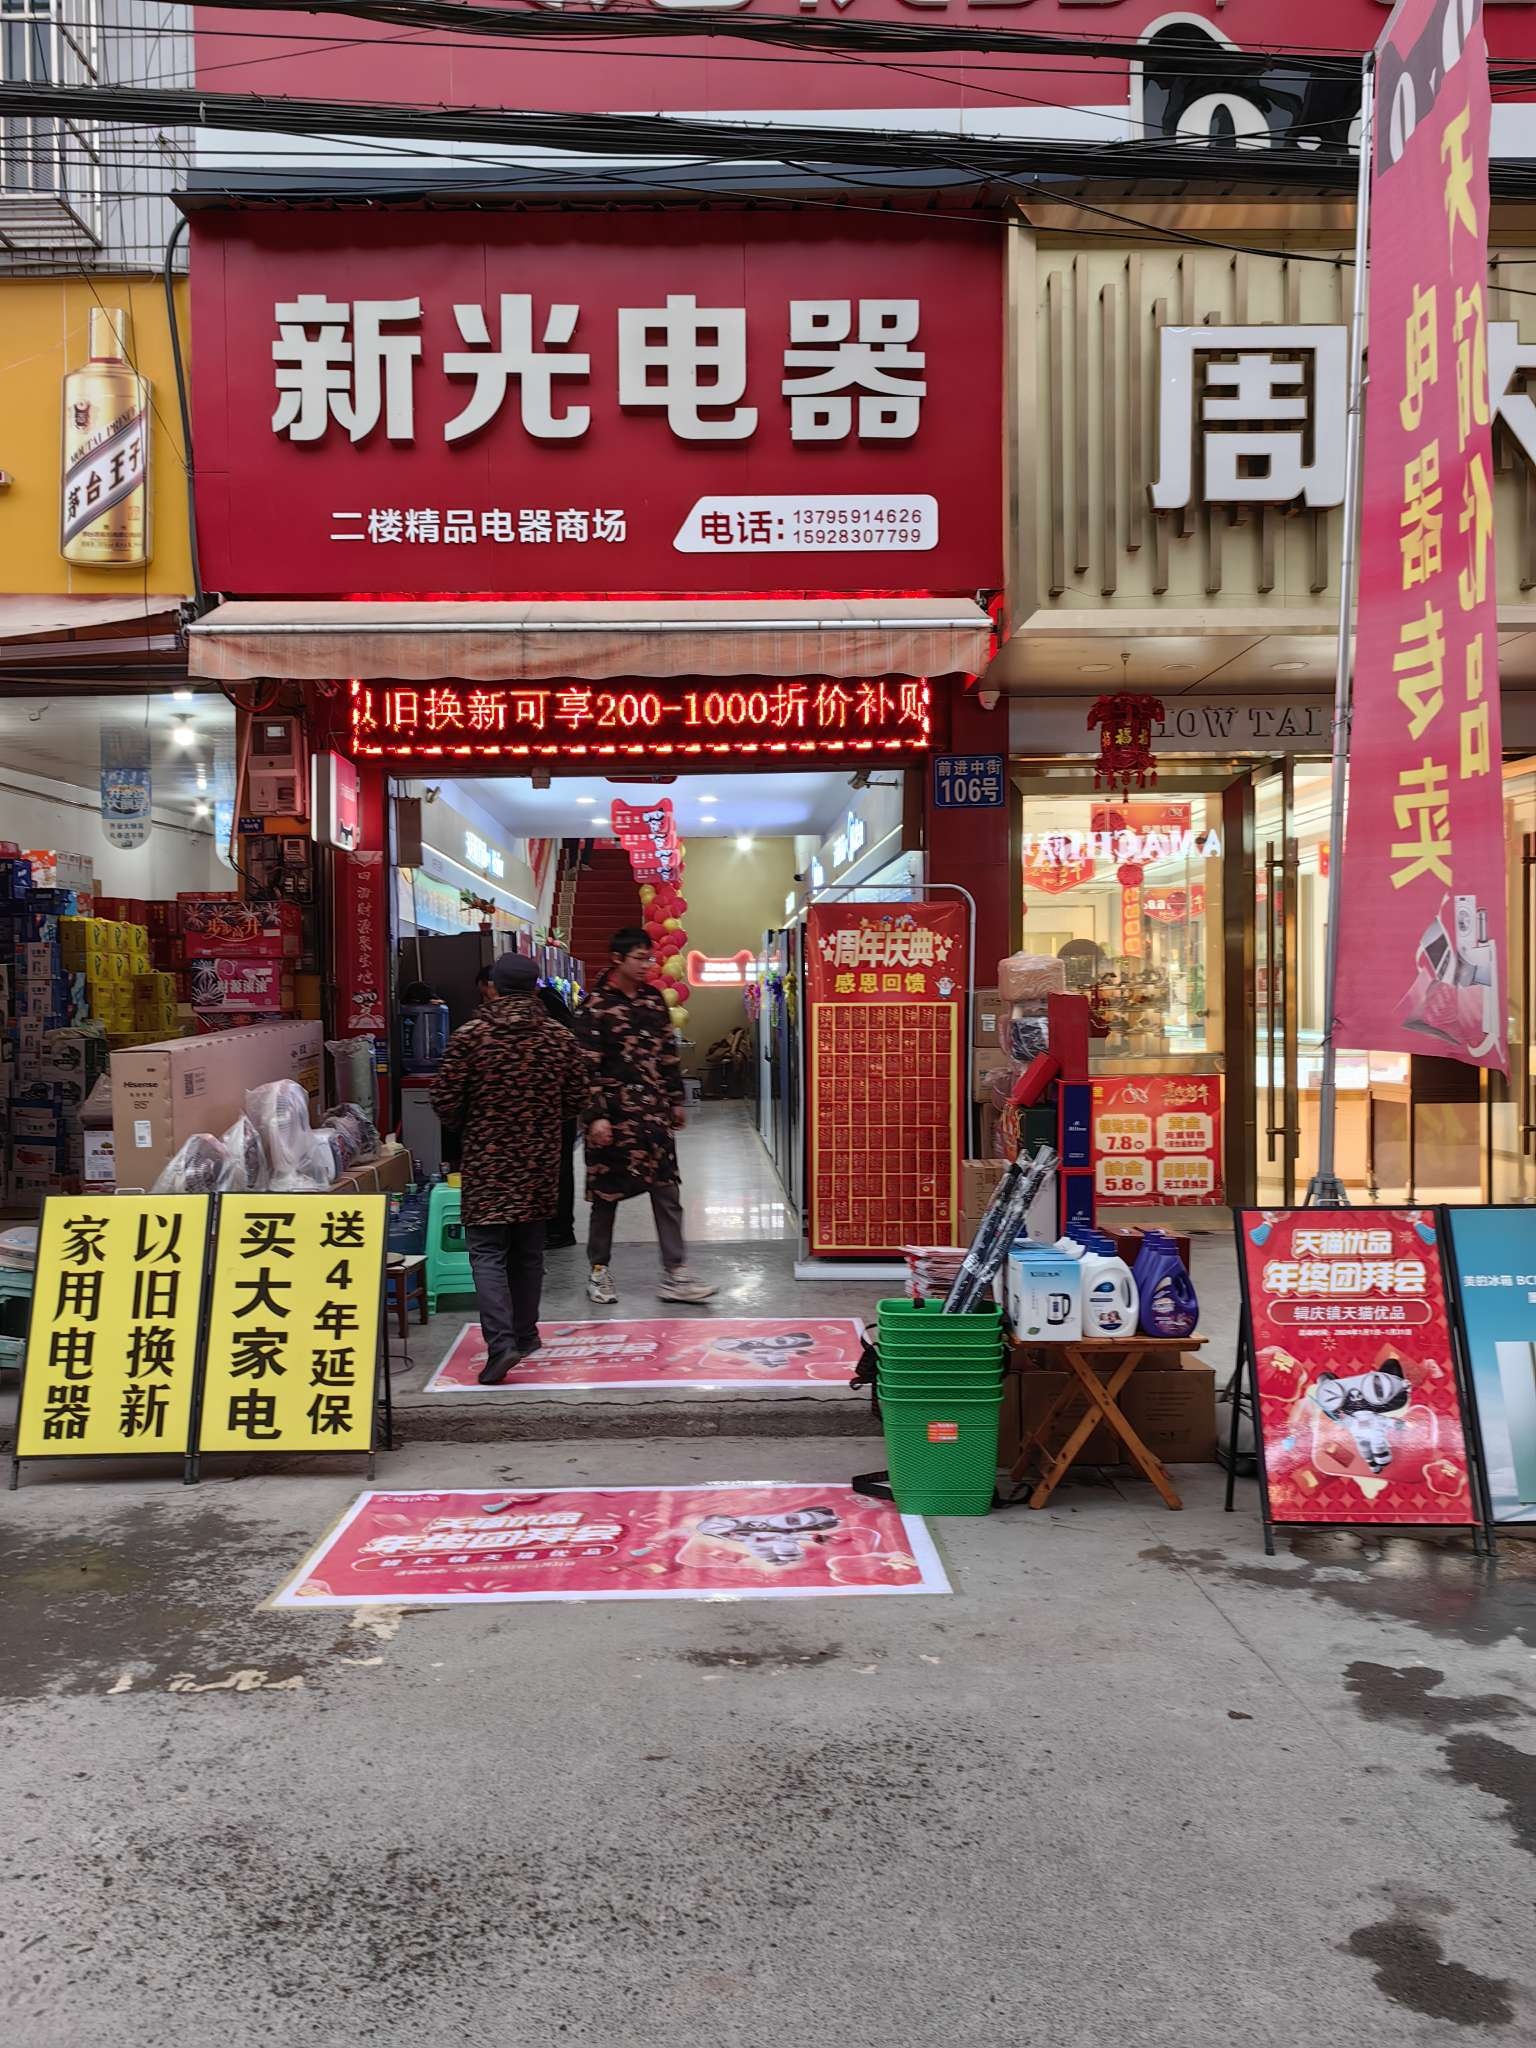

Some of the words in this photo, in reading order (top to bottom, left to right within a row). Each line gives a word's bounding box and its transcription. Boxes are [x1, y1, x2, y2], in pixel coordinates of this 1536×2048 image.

[272, 293, 928, 443] 新光电器
[67, 438, 141, 522] 茅台王子
[330, 508, 627, 545] 二楼精品电器商场
[793, 509, 923, 525] 13795914626
[793, 528, 922, 544] 15928307799
[937, 759, 1001, 777] 前进中街
[940, 777, 999, 803] 106号
[834, 927, 935, 968] 周年庆典
[834, 972, 926, 993] 感恩回馈
[1295, 1230, 1393, 1255] 天猫优品
[1265, 1260, 1427, 1293] 年终团拜会
[43, 1214, 110, 1440] 家用电器
[119, 1213, 182, 1438] 以旧换新
[227, 1212, 296, 1440] 买大家电
[306, 1210, 366, 1436] 送4年延保
